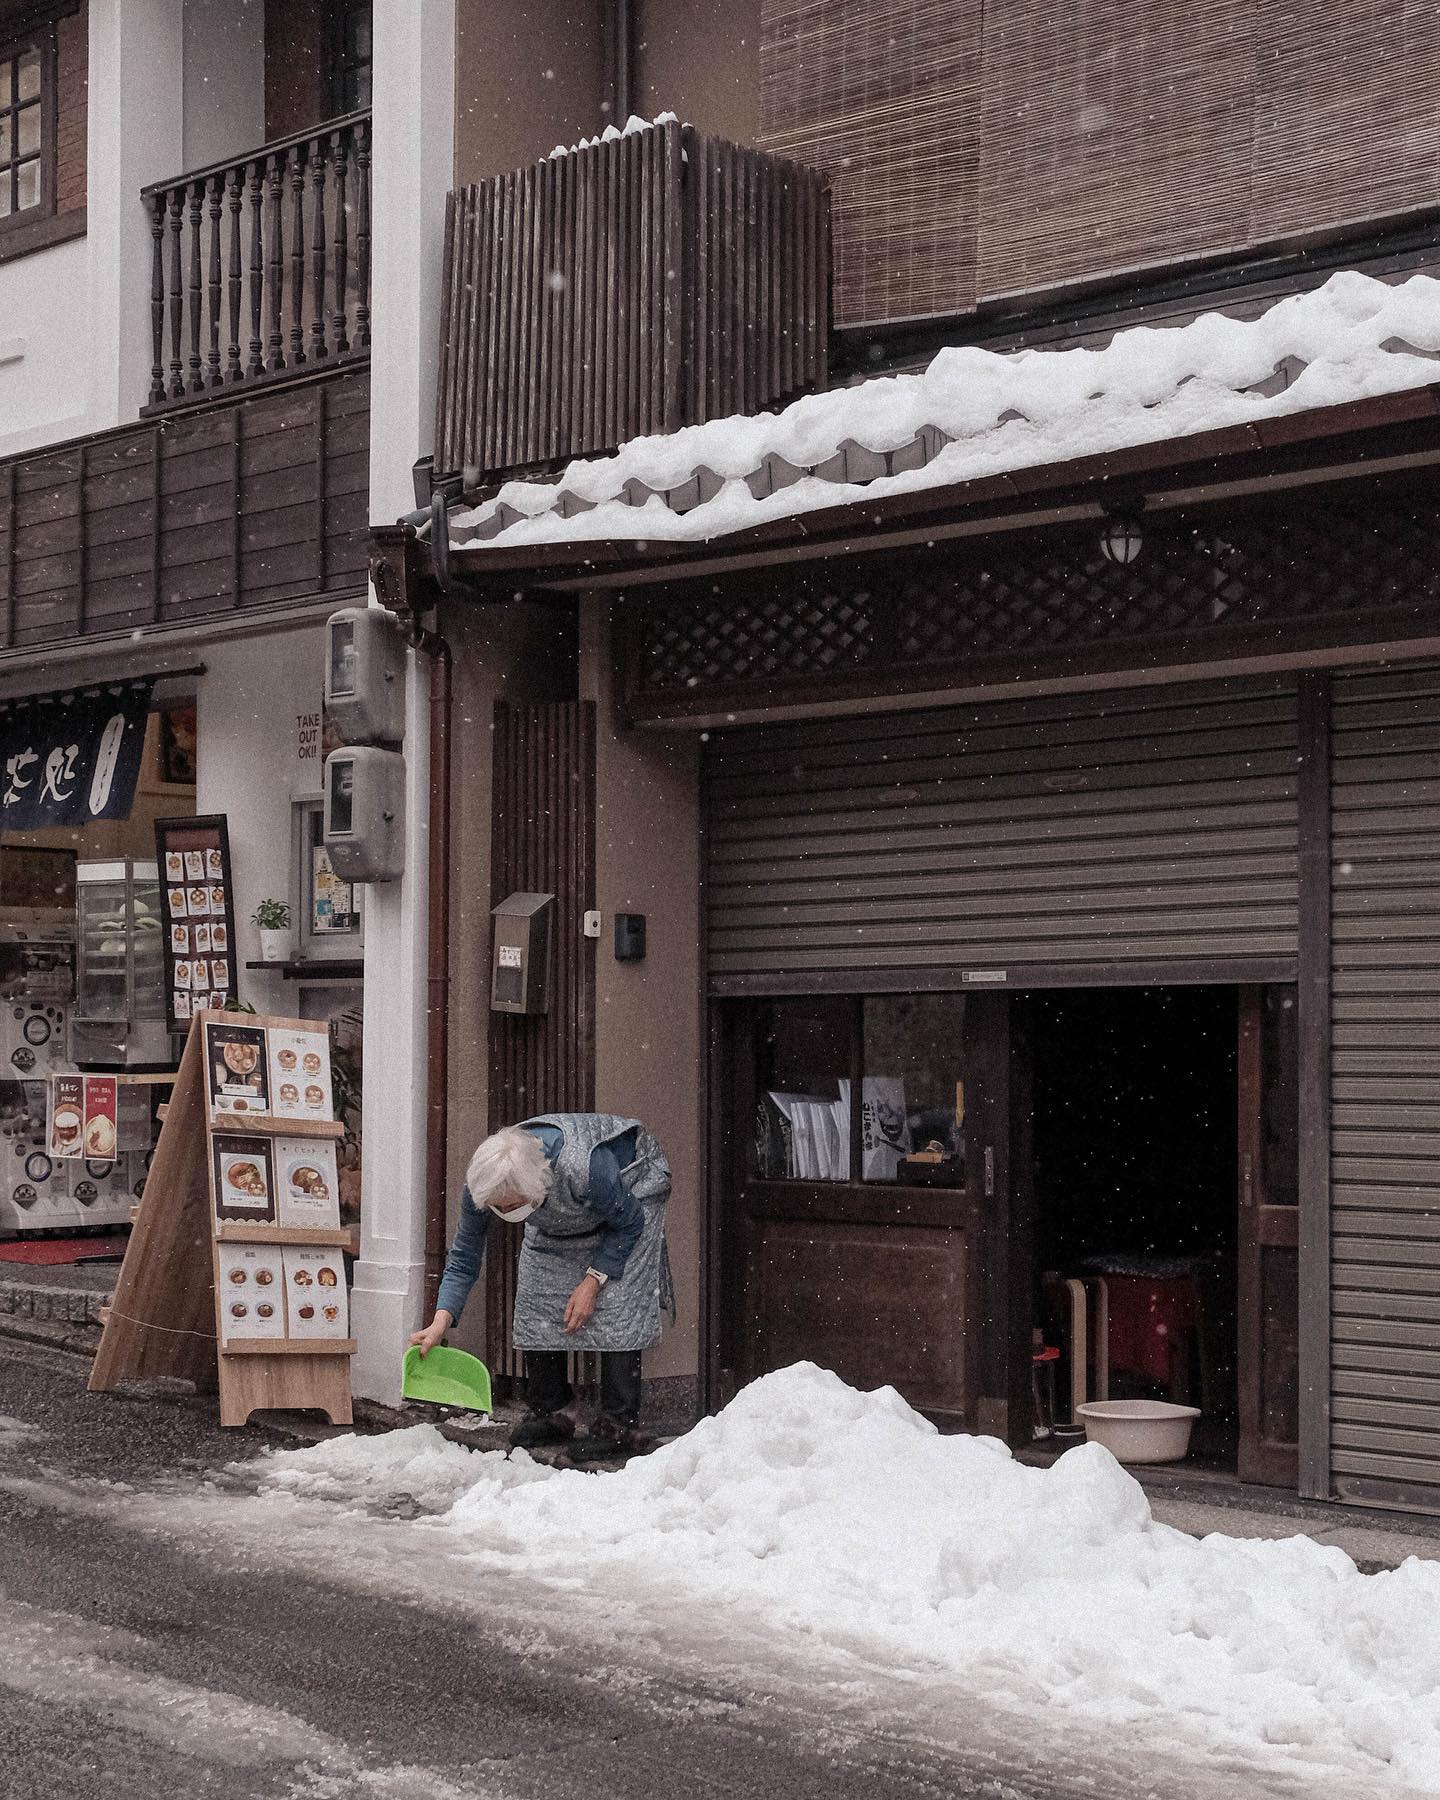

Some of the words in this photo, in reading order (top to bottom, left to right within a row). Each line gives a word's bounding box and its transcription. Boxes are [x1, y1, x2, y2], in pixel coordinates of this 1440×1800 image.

[296, 713, 320, 728] TAKE
[298, 729, 318, 743] OUT
[298, 745, 317, 759] OK!!
